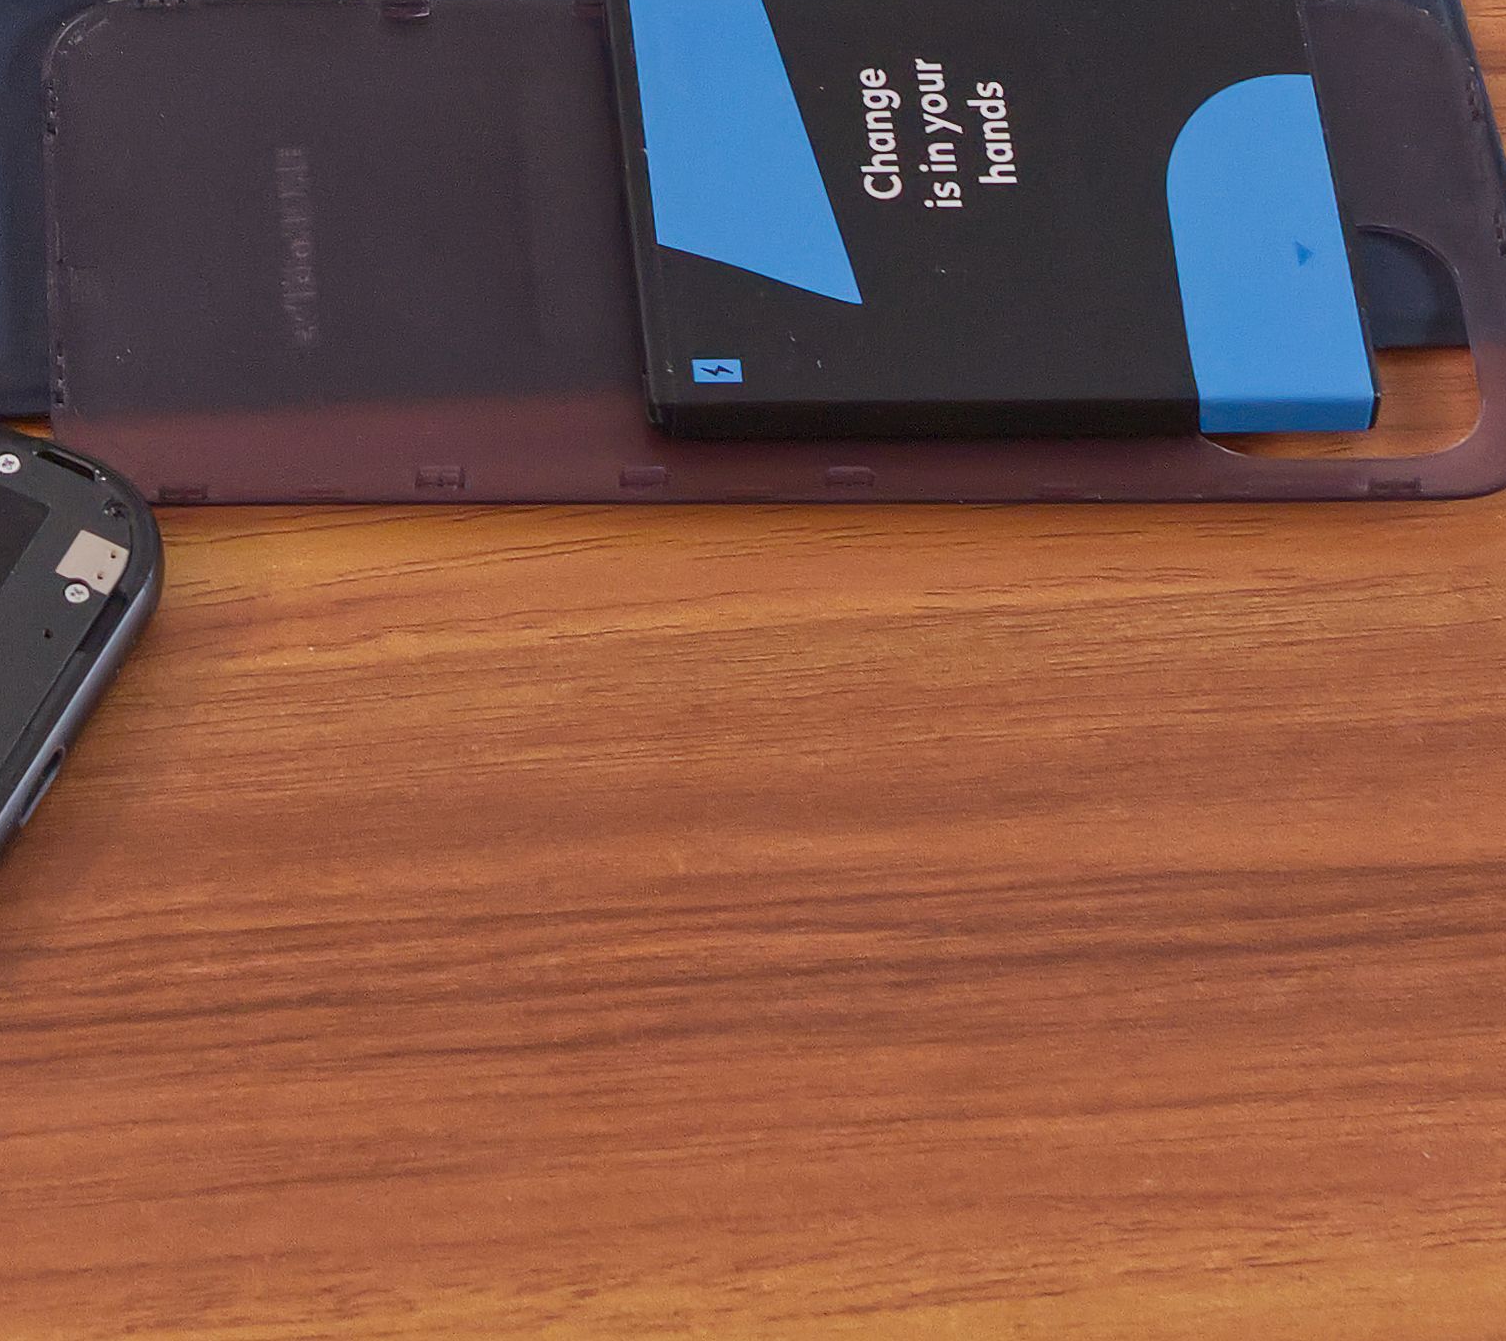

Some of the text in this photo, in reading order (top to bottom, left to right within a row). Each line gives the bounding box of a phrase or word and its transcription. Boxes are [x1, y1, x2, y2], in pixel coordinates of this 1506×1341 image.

[859, 68, 902, 199] Change
[915, 58, 963, 208] is in your
[967, 81, 1017, 183] hands
